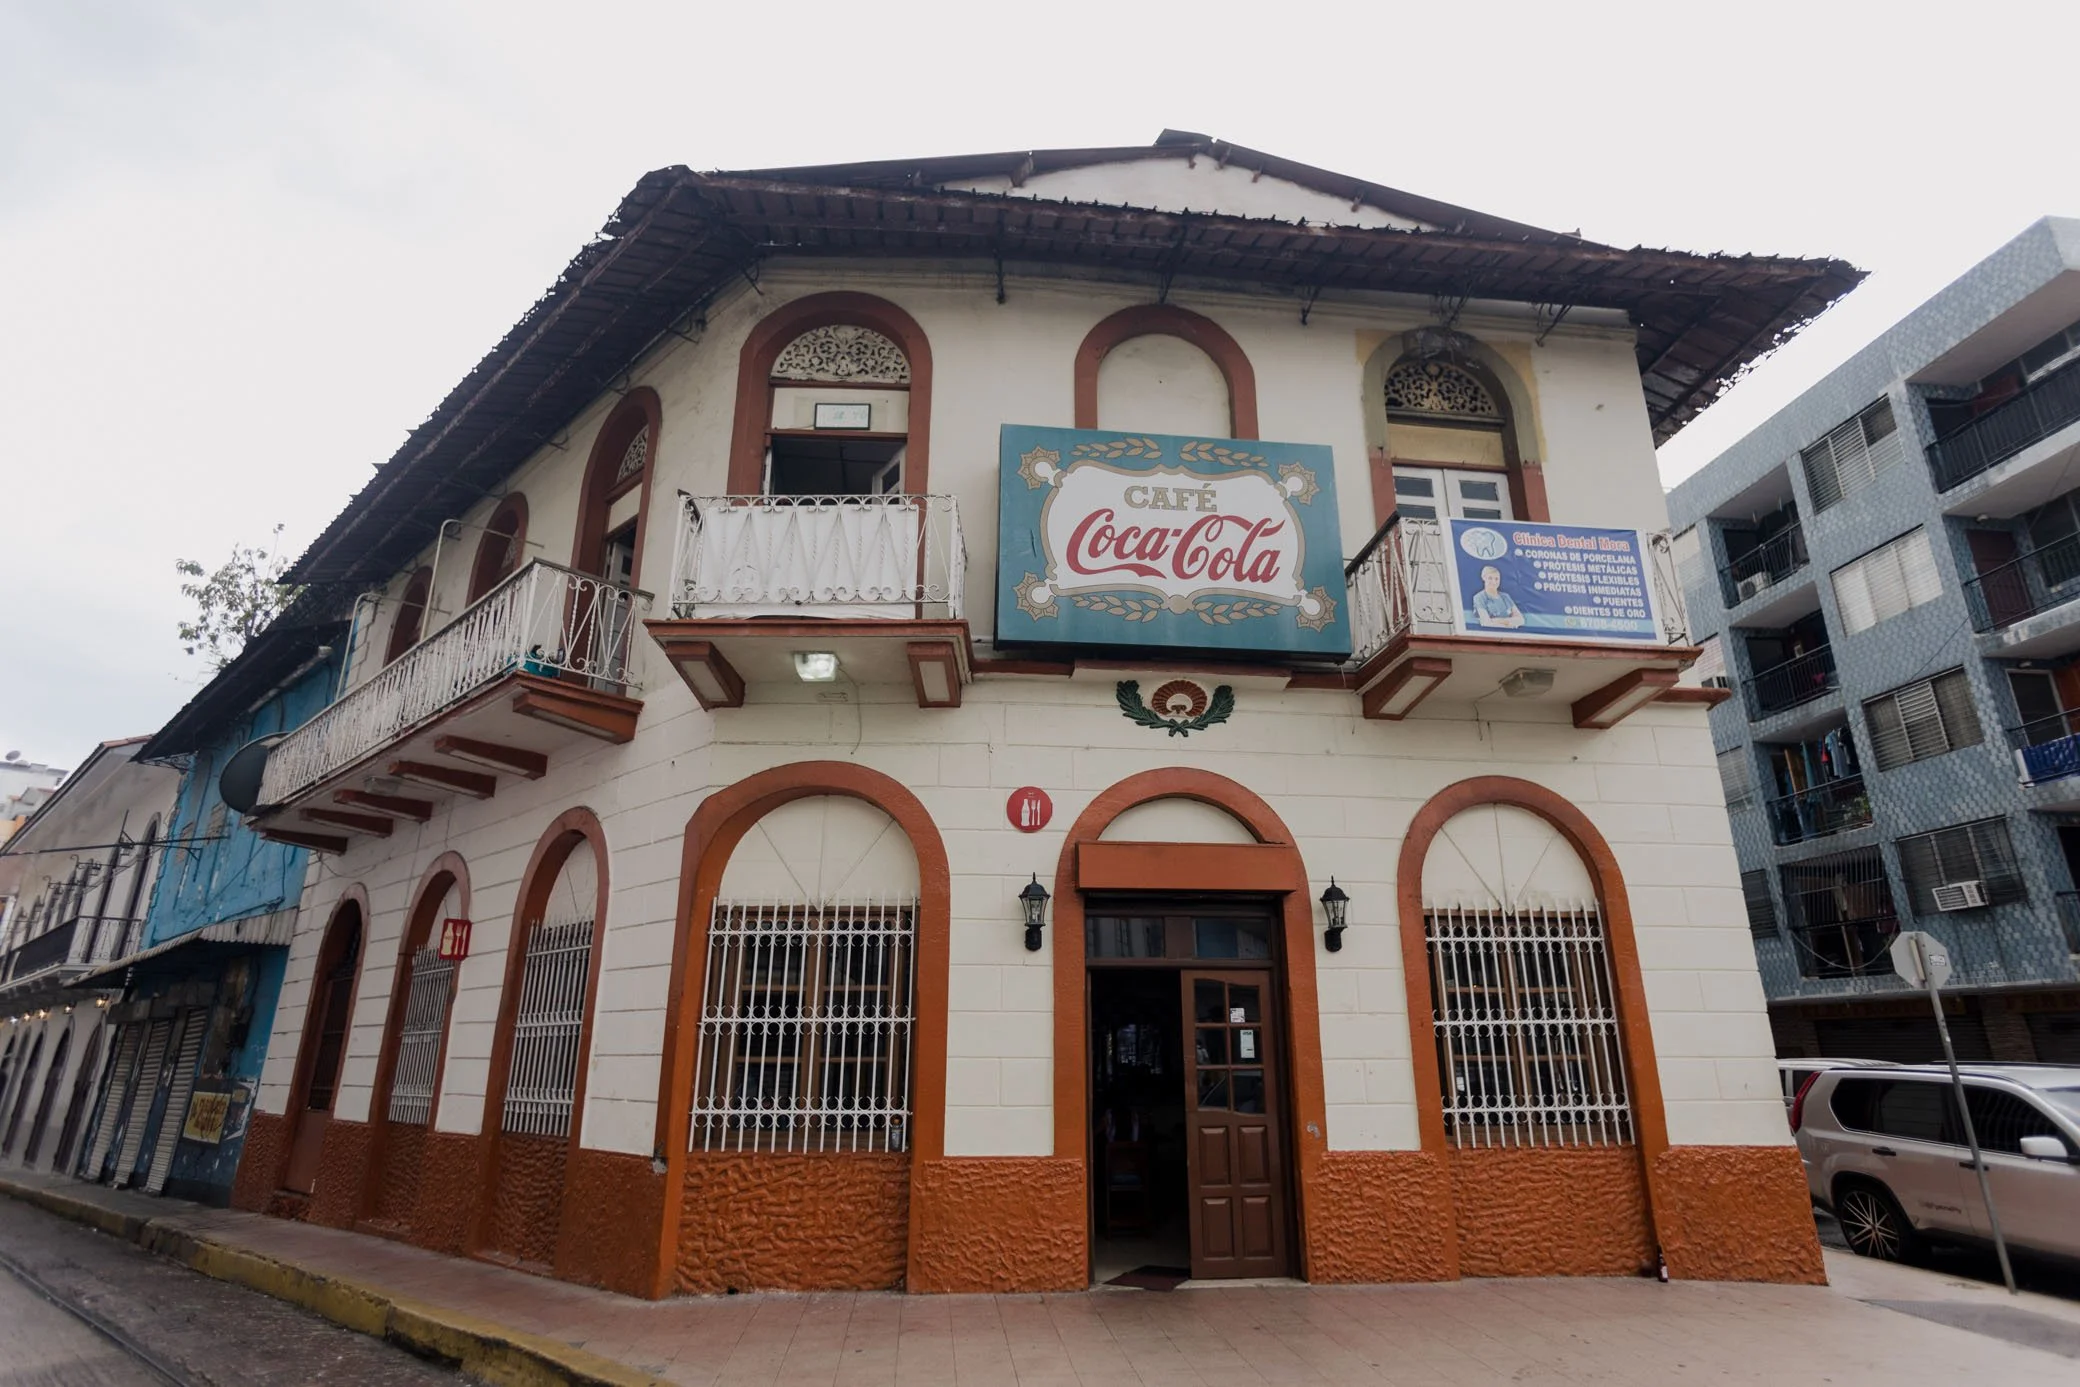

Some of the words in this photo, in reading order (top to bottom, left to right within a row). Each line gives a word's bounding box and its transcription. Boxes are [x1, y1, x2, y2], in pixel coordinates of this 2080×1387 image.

[1124, 483, 1217, 512] CAFÉ
[1066, 508, 1286, 583] Coca-Cola
[1557, 534, 1597, 550] Dental
[1599, 537, 1631, 551] Mora
[1525, 549, 1568, 560] CORONAS
[1570, 552, 1581, 561] DE
[1583, 553, 1636, 564] PORCELANA
[1543, 560, 1586, 572] PRÓTESIS
[1587, 563, 1638, 575] METÁLICAS
[1547, 571, 1591, 583] PRÓTESIS
[1592, 575, 1640, 586] FLEXIBLES
[1543, 581, 1587, 593] PRÓTESIS
[1588, 585, 1642, 597] INMEDIATAS
[1602, 597, 1644, 607] PUENTES
[1572, 606, 1611, 617] DIENTES
[1613, 608, 1625, 617] DE
[1626, 609, 1646, 618] ORO
